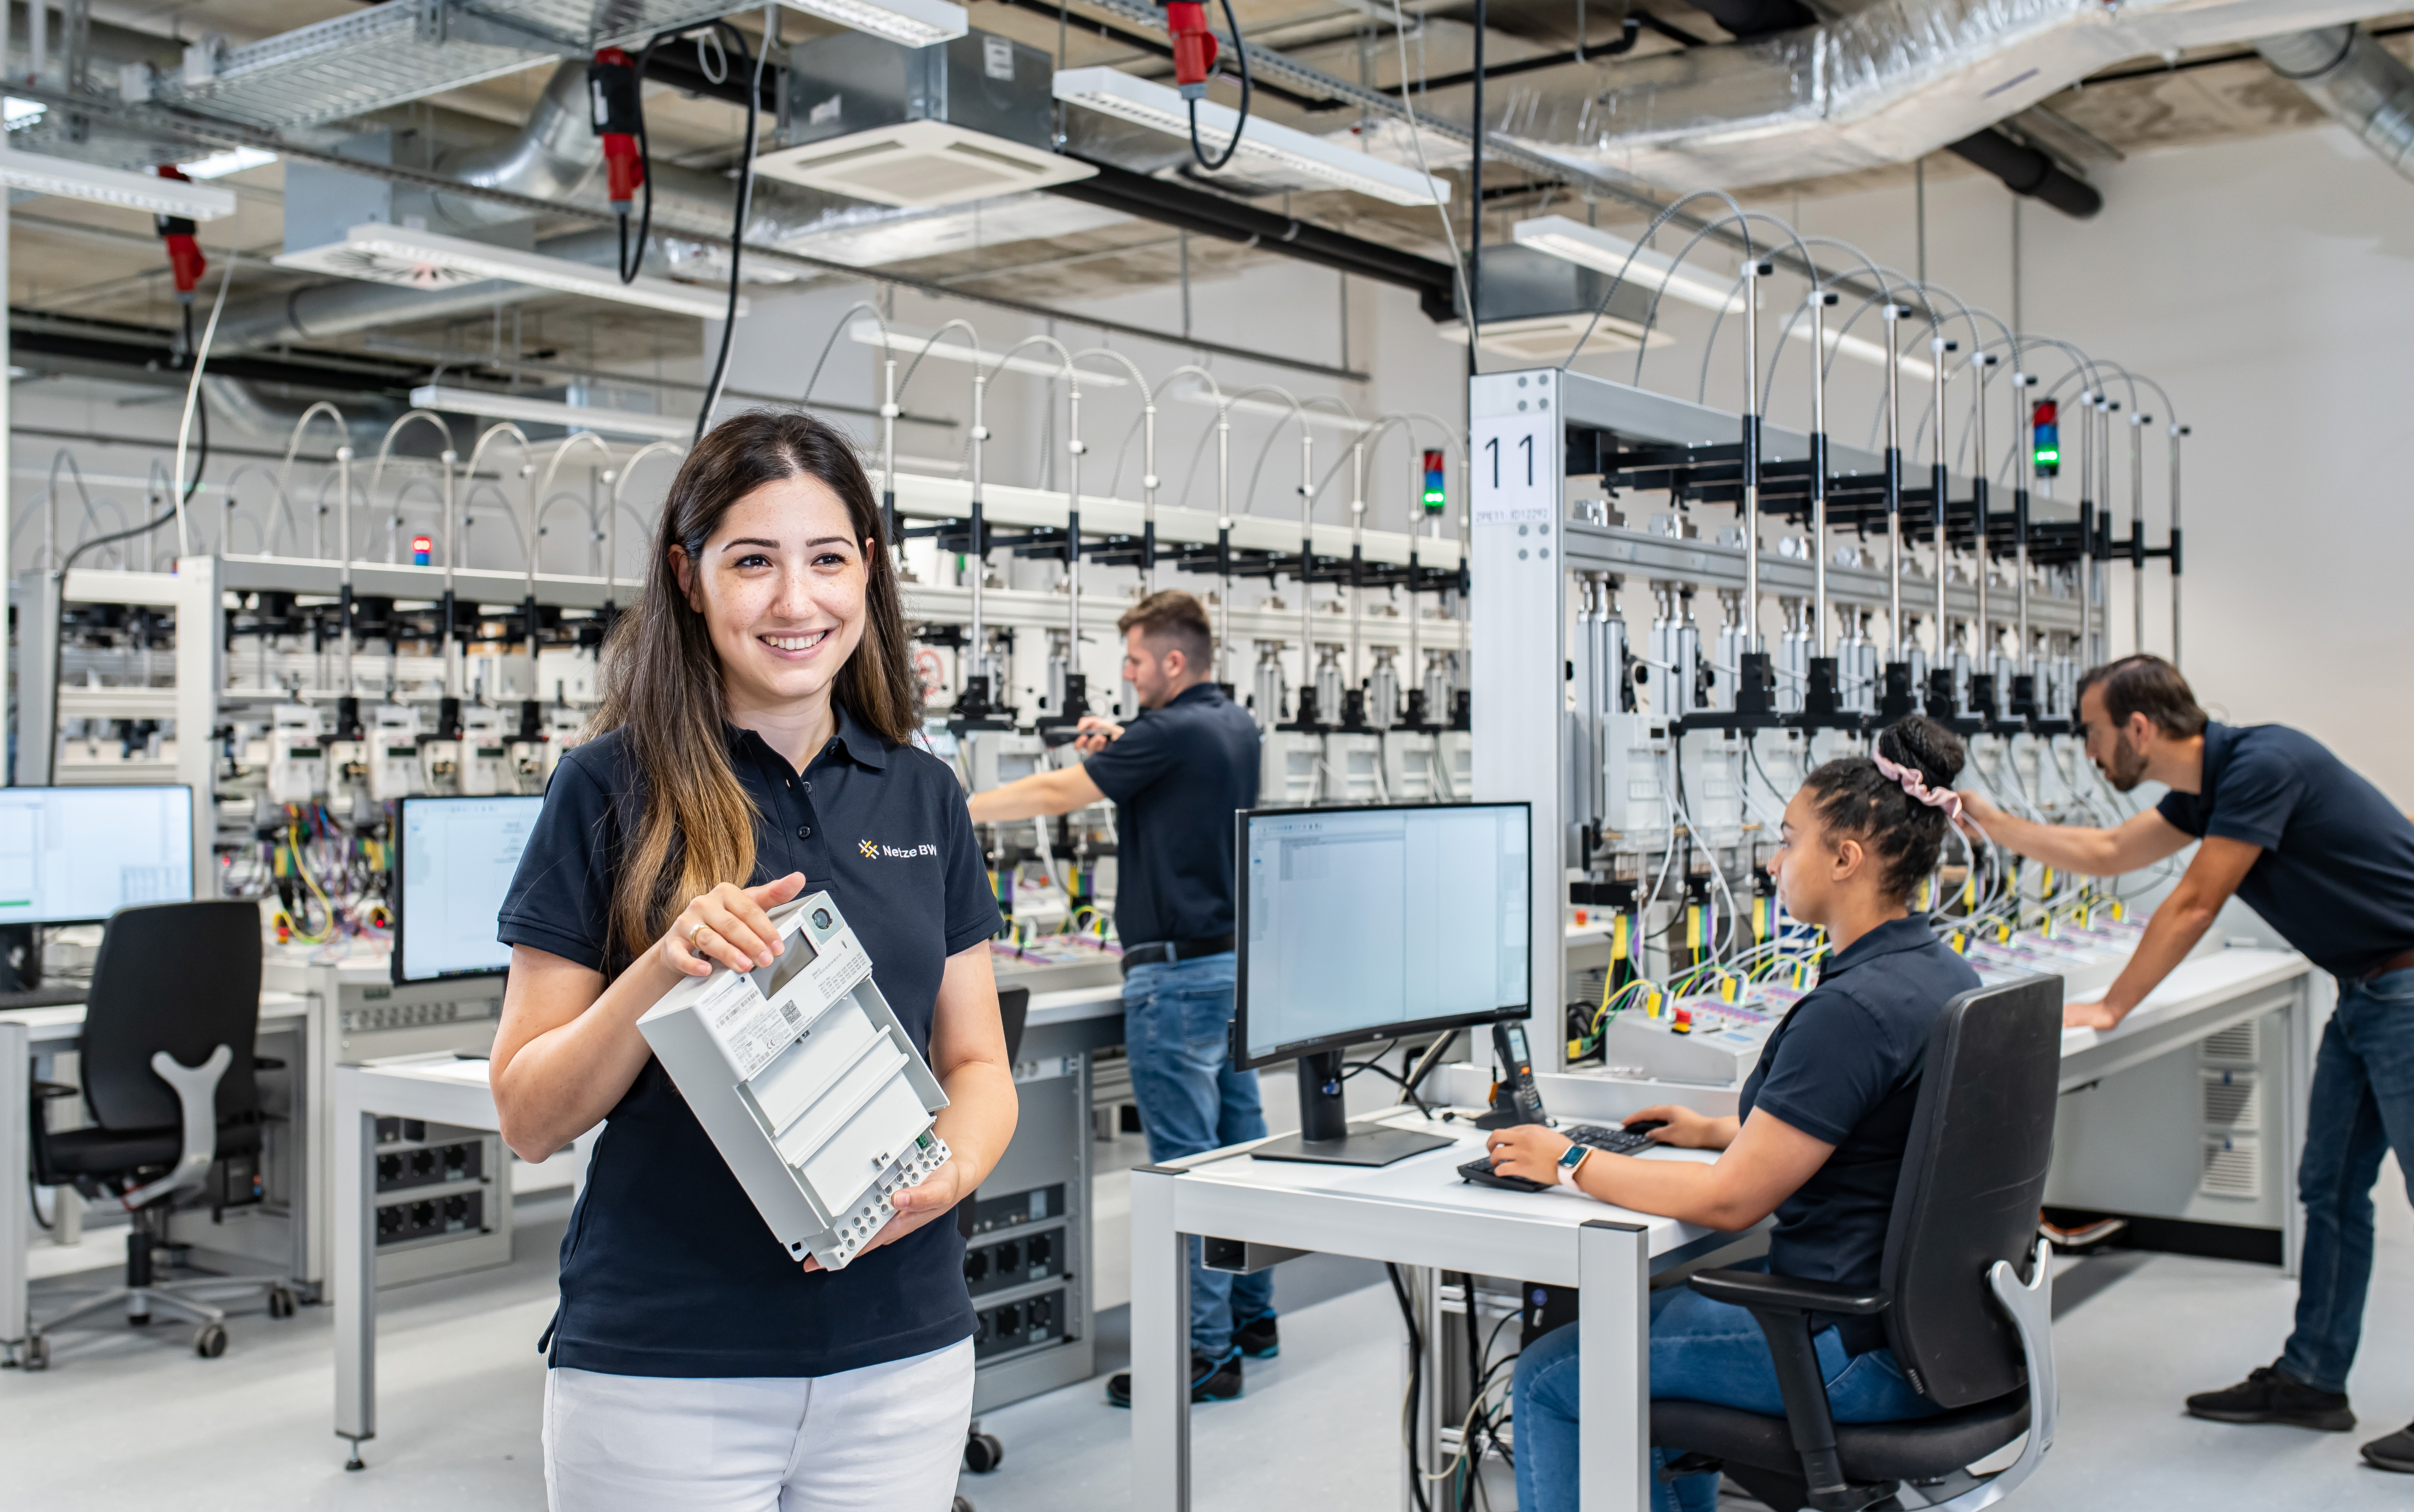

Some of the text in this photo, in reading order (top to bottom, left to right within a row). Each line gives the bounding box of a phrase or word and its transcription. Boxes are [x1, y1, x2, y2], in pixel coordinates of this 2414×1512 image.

[1484, 433, 1534, 489] 11
[882, 844, 937, 858] Netze BW
